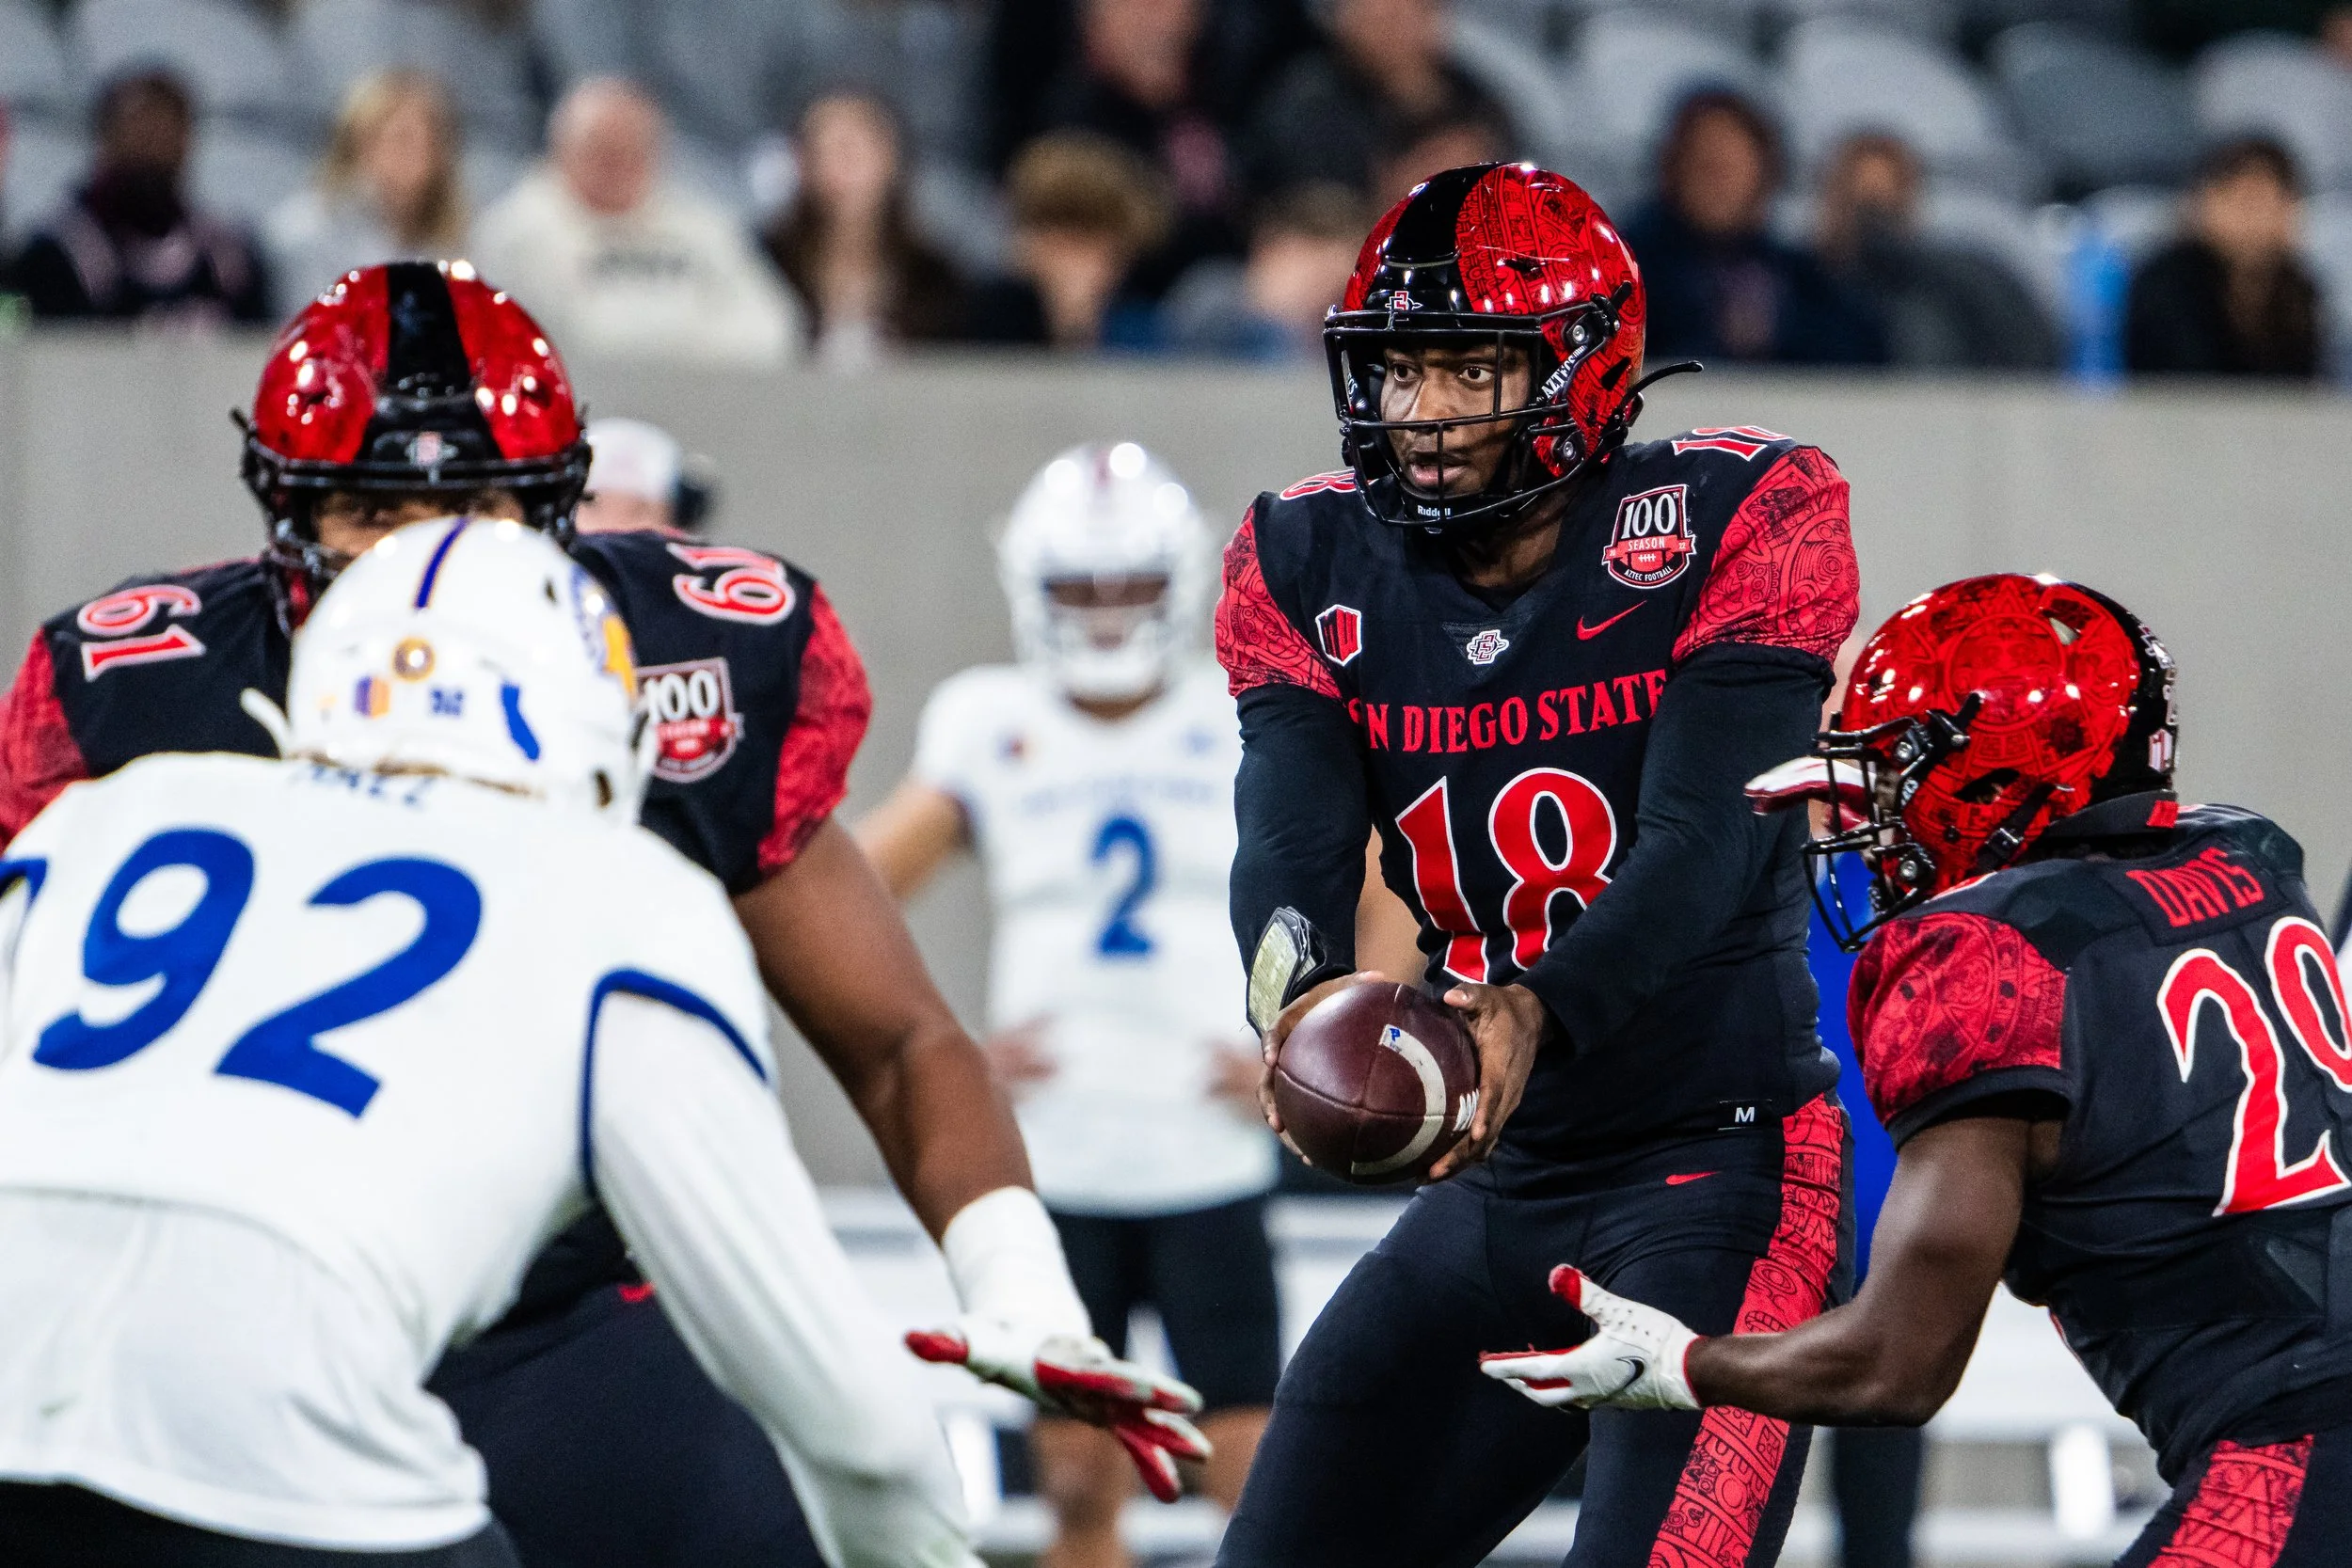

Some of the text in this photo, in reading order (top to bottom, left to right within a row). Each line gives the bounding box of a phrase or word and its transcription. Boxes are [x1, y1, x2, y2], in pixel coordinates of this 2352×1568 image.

[1541, 355, 1576, 399] AZTECS
[1620, 493, 1677, 539] 100
[1627, 537, 1665, 551] SEASON
[665, 543, 796, 626] 61
[1624, 565, 1674, 581] AZTEC FOOTBALL
[77, 584, 207, 682] 61
[1348, 669, 1667, 752] SN DIEGO STATE
[1089, 816, 1158, 955] 2
[1395, 768, 1617, 985] 18
[2126, 847, 2265, 927] DAVIS
[31, 823, 484, 1120] 92
[1734, 1106, 1756, 1123] M
